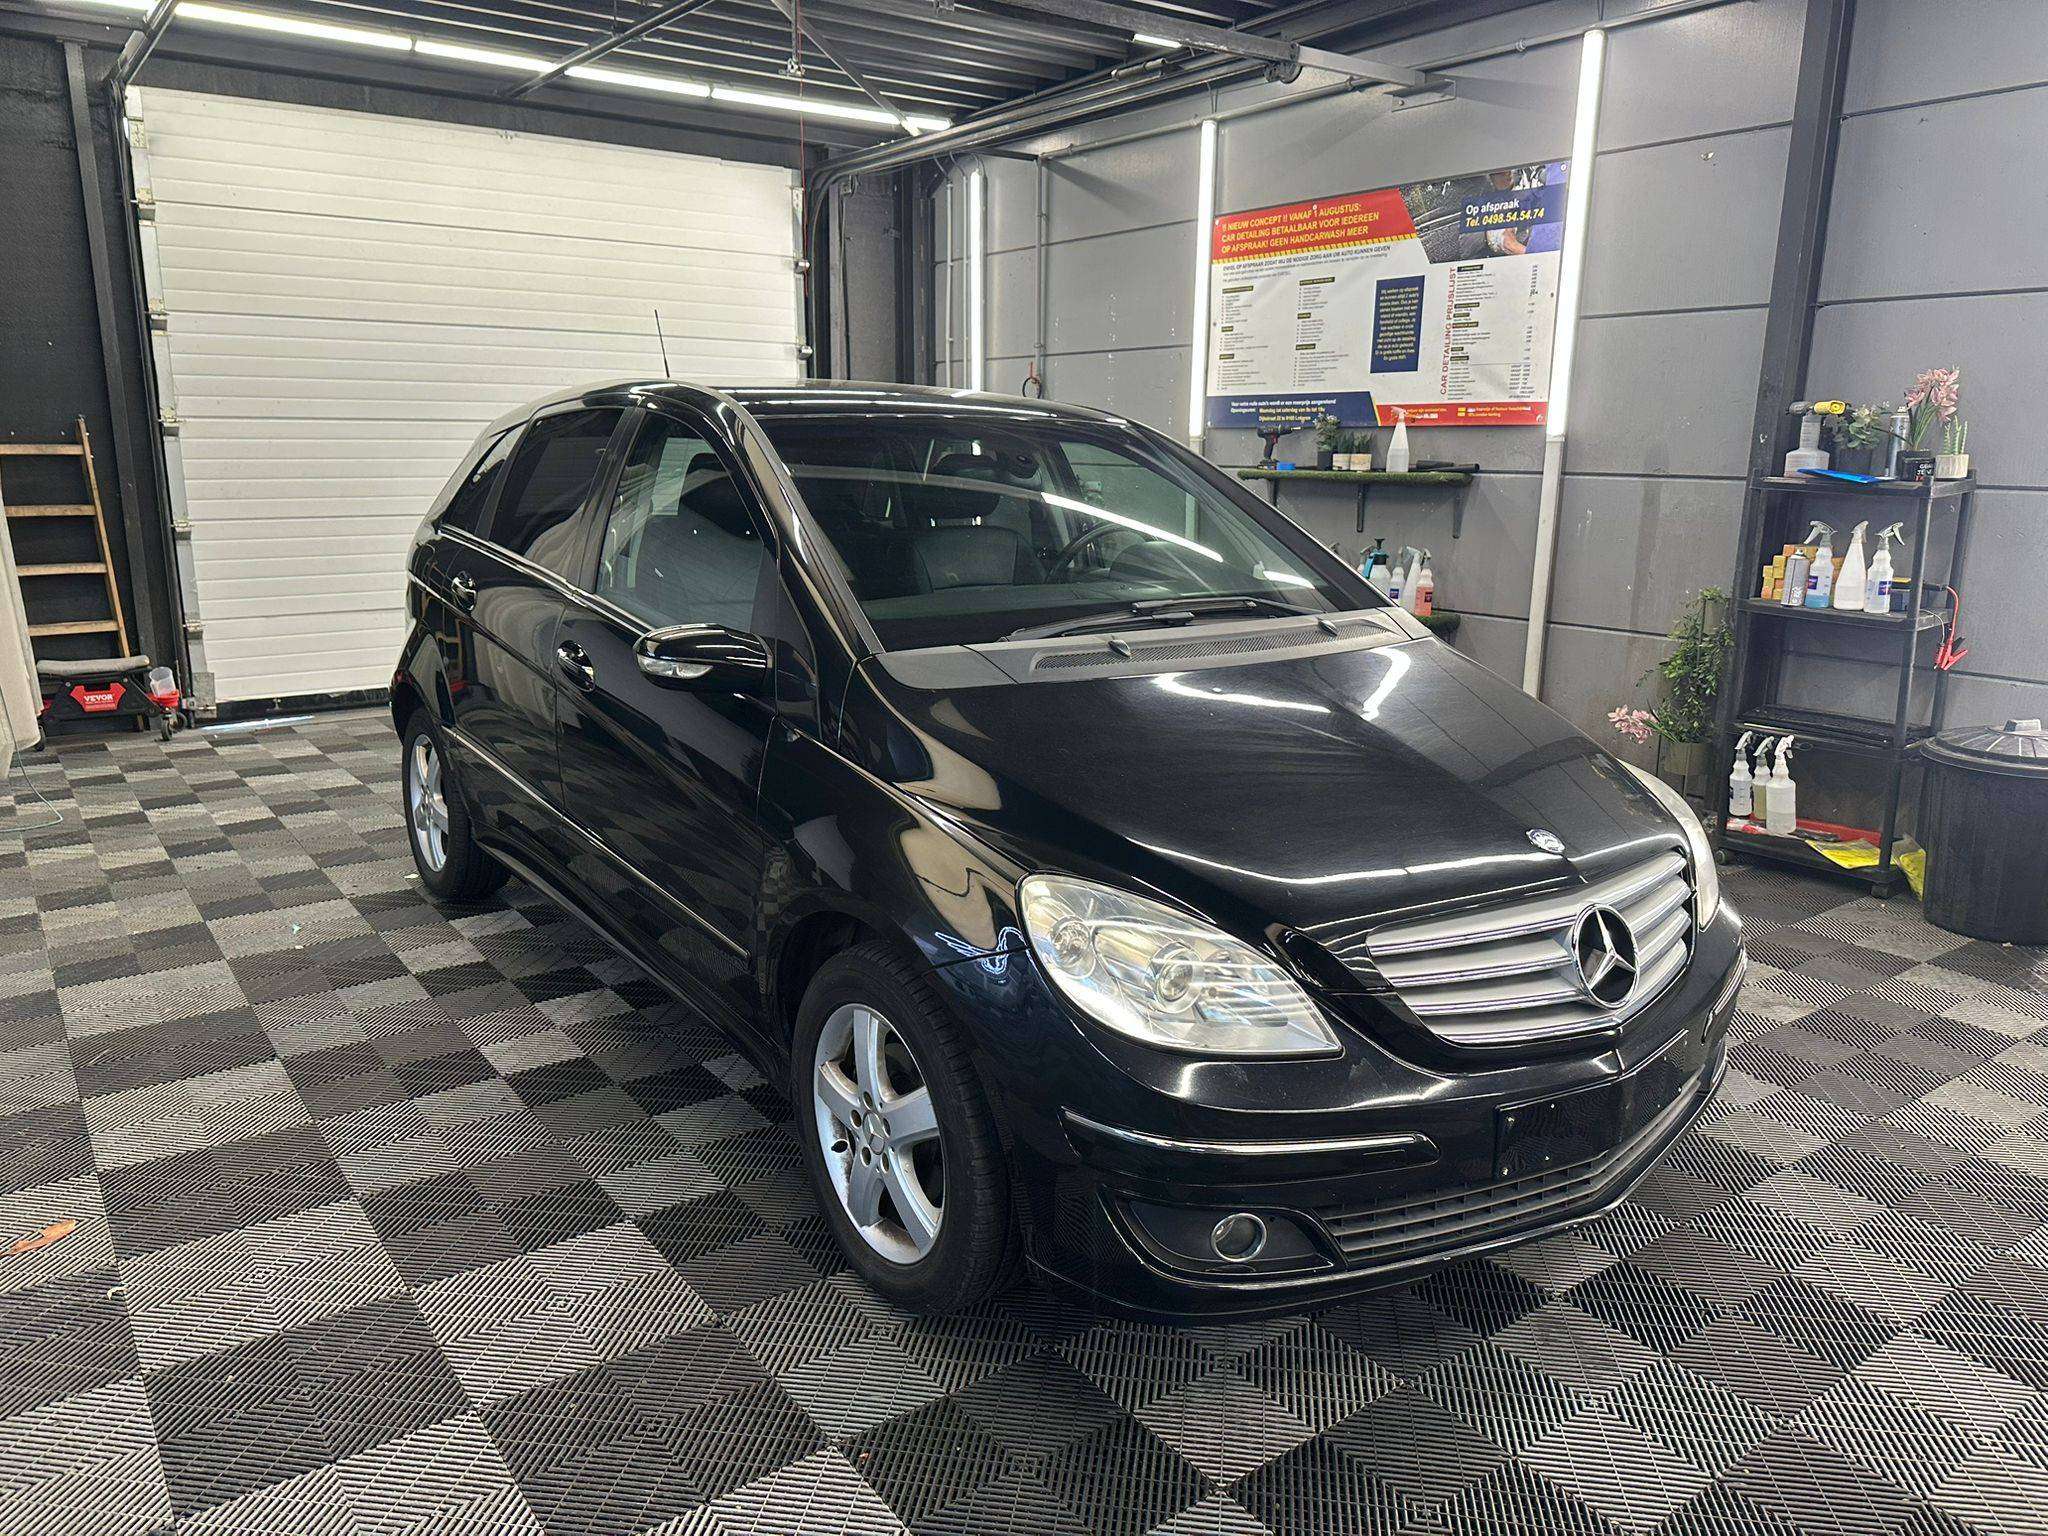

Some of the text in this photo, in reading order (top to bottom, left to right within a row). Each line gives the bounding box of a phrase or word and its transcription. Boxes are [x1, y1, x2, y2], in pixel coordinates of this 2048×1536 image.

[1466, 198, 1520, 216] Op afspraak
[1221, 211, 1380, 243] CAR DETAILING BETAALBAAR VOOR IEDEREEN
[1228, 220, 1249, 230] NIEUW
[1249, 215, 1281, 227] CONCEPT
[1466, 208, 1545, 227] Tel. 0498.54.54.74
[1221, 245, 1231, 254] OP
[1269, 237, 1289, 247] GEEN
[1290, 228, 1346, 242] HANDCARWASH
[1347, 225, 1369, 236] MEER
[1442, 323, 1452, 373] DETAILING
[1440, 375, 1448, 395] CAR
[83, 693, 114, 702] VEVOR
